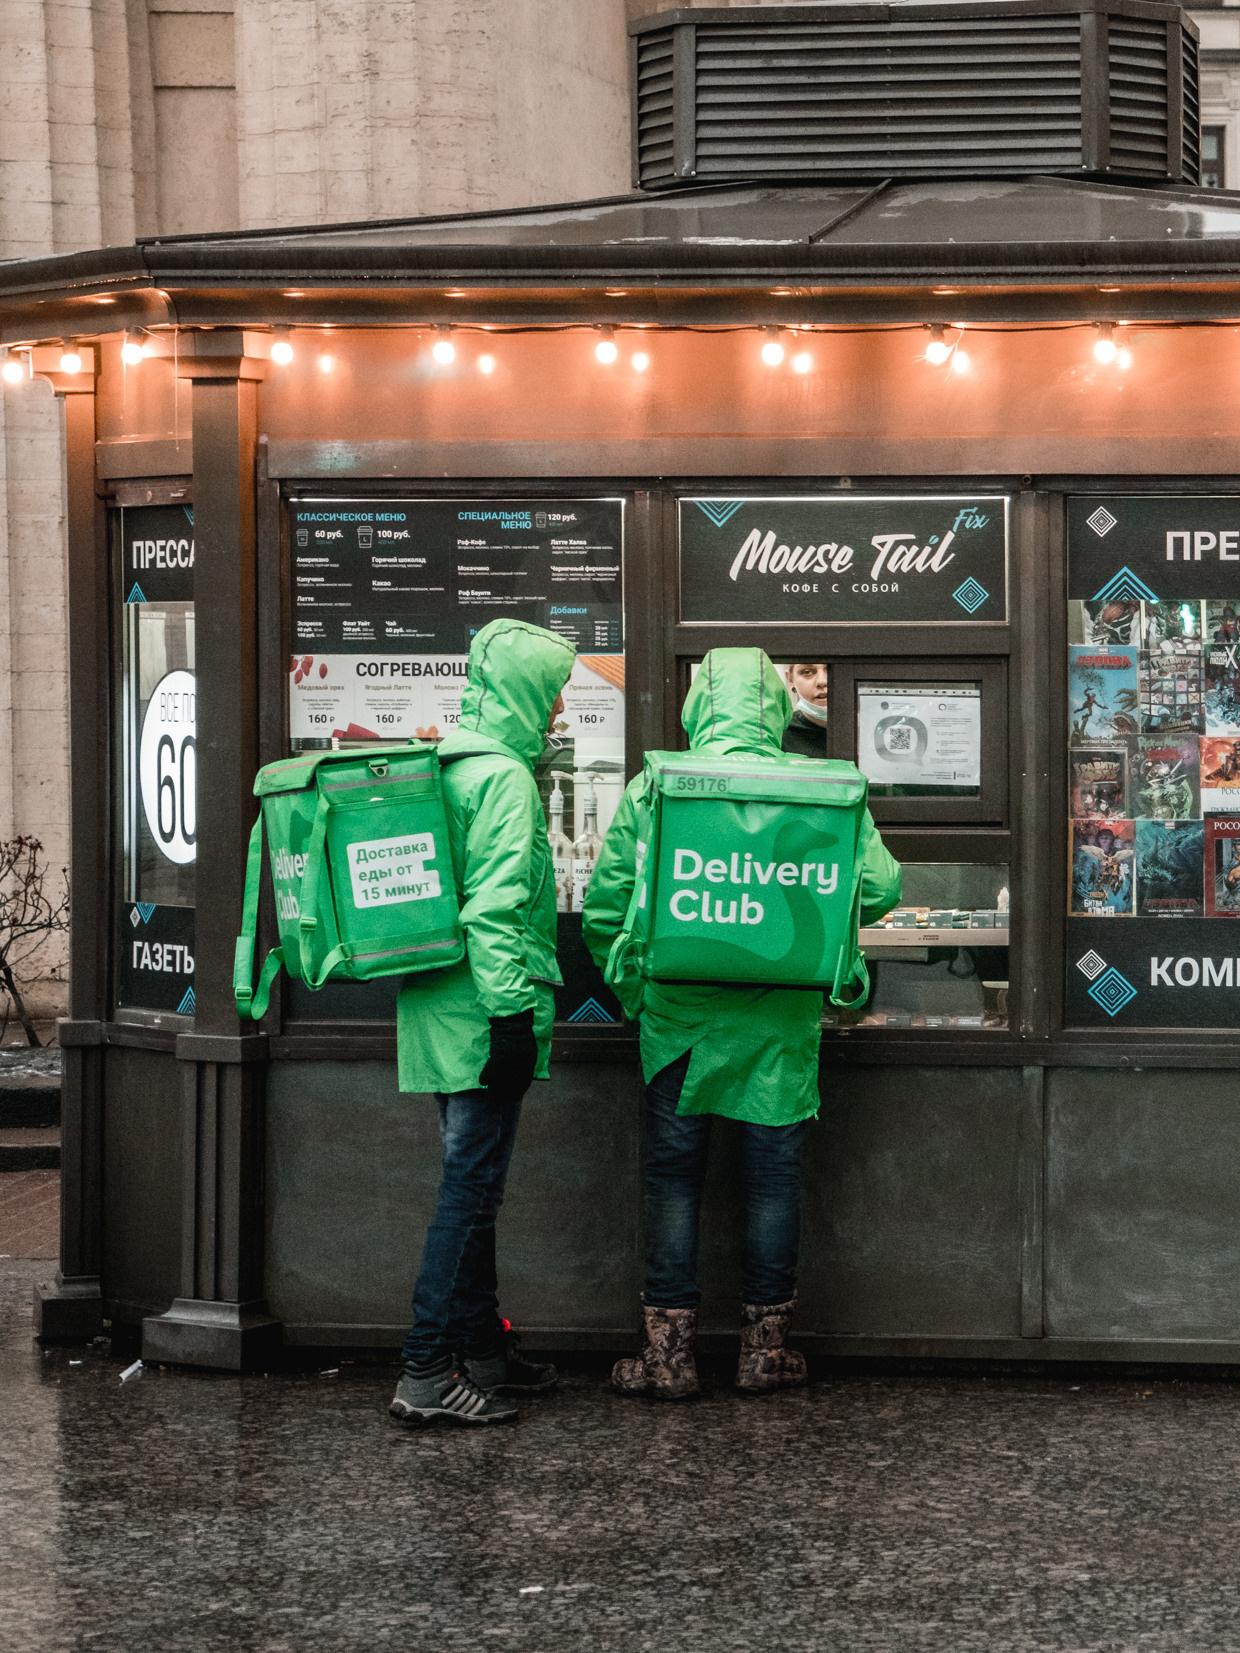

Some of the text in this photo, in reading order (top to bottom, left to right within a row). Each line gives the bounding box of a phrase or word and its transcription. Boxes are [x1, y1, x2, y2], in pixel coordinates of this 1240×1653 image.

[297, 513, 407, 521] КЛАССИЧЕСКОЕ МЕНЮ
[458, 512, 532, 529] СПЕЦИАЛЬНОЕ МЕНЮ
[952, 507, 990, 532] Fix
[315, 530, 344, 539] 60 руб.
[377, 530, 411, 539] 100 руб.
[729, 528, 955, 581] Mouse Tail
[783, 581, 899, 593] КОФЕ С СОБОЙ
[550, 605, 587, 615] Добавки
[356, 662, 469, 679] СОГРЕВАЮЩ
[160, 692, 178, 723] ВСЕ
[309, 714, 327, 723] 160
[376, 714, 394, 723] 160
[578, 714, 597, 724] 160
[677, 777, 727, 792] 59176
[356, 842, 428, 864] Доставка
[358, 865, 412, 882] еды от
[673, 849, 839, 895] Delivery
[361, 882, 430, 901] 15 минут
[670, 889, 764, 925] Club
[1083, 899, 1103, 908] БИТВА
[1088, 905, 1115, 917] АТОМА
